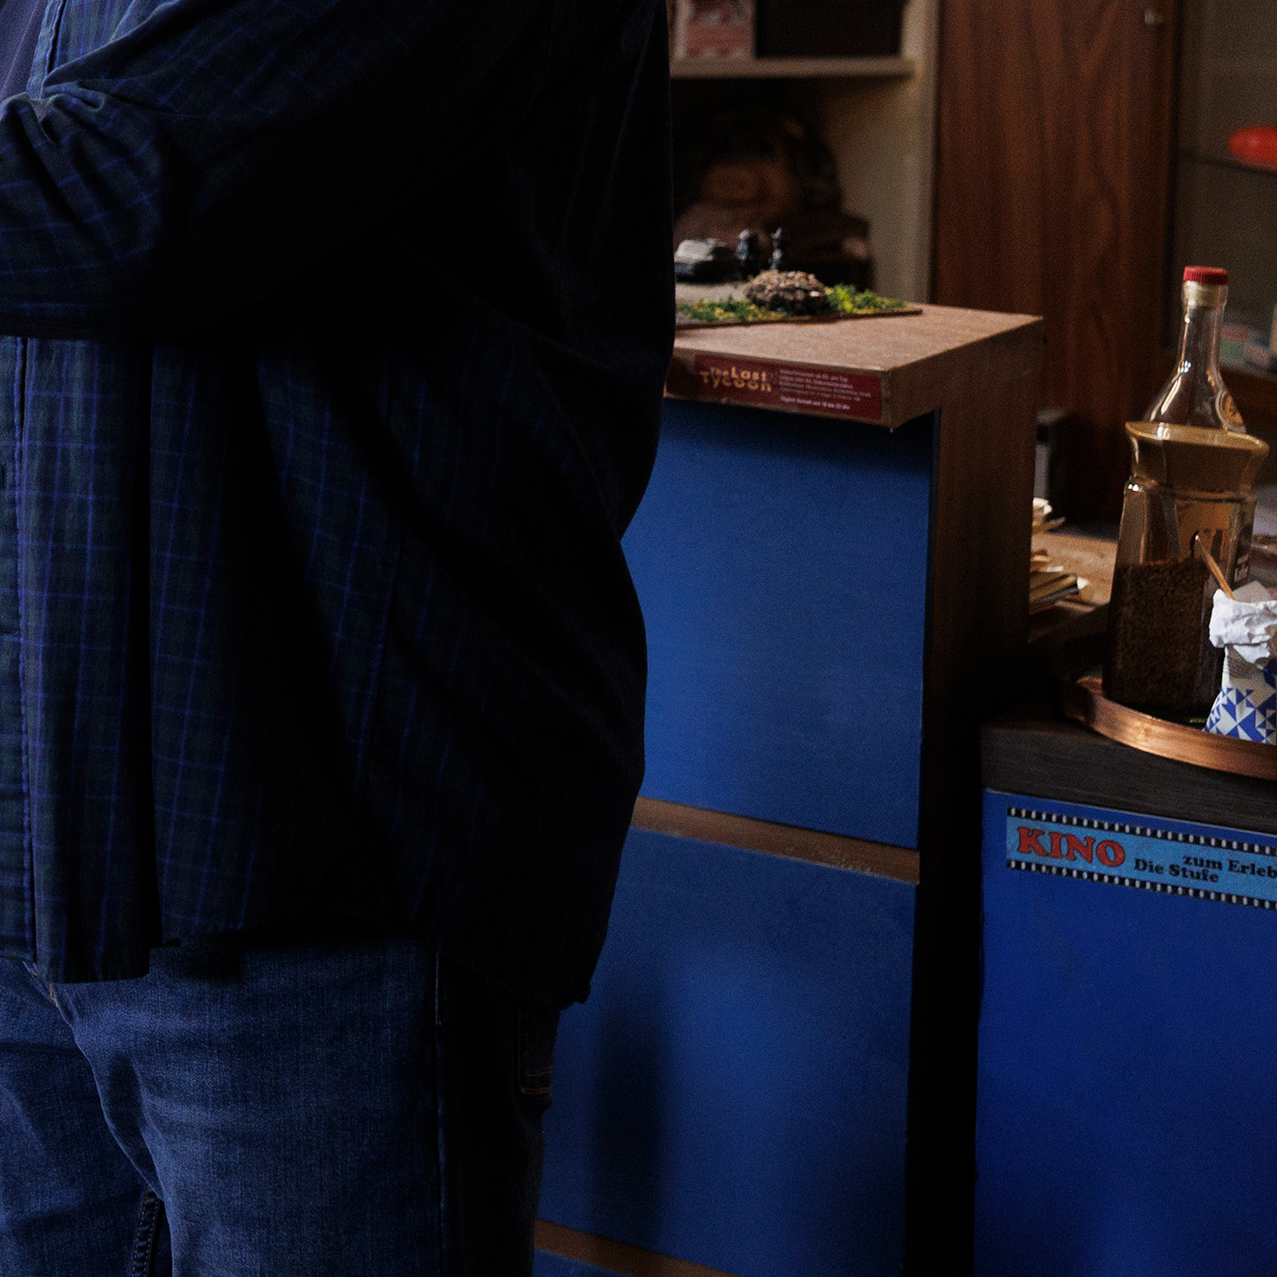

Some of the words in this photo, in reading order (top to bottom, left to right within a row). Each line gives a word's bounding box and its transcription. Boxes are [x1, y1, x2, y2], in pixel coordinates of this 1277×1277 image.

[730, 365, 768, 382] Last
[1016, 826, 1126, 868] KINO
[1134, 858, 1165, 875] Die
[1182, 855, 1223, 872] zum
[1227, 859, 1277, 881] Erleb
